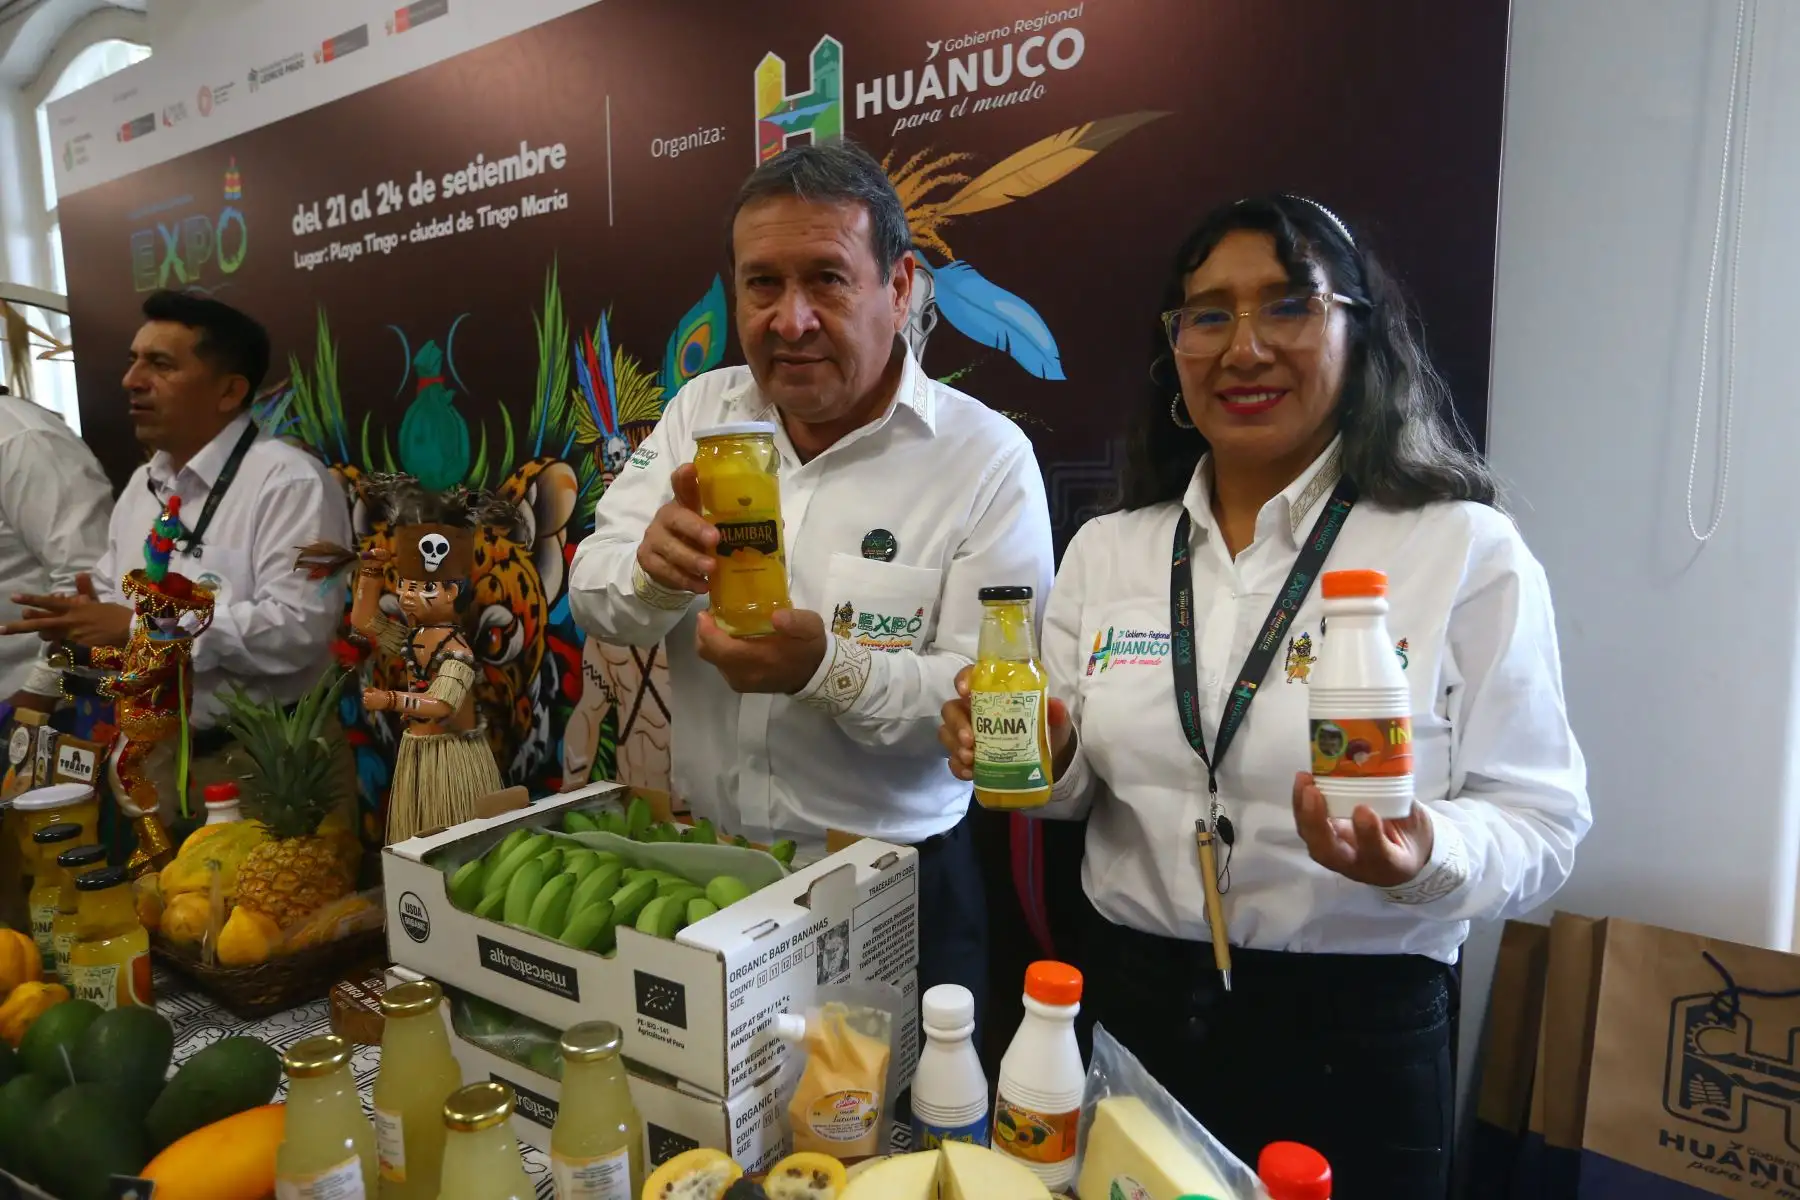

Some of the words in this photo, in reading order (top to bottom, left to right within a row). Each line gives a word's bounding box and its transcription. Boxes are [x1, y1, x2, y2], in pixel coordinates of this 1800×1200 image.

[944, 26, 1010, 52] Gobierno
[1014, 2, 1084, 34] Regional
[892, 107, 942, 136] para
[950, 97, 968, 118] el
[972, 81, 1047, 113] mundo
[651, 126, 726, 158] Organiza:
[293, 203, 322, 235] del
[326, 194, 347, 228] 21
[351, 188, 371, 222] al
[376, 180, 403, 216] 24
[408, 171, 436, 207] de
[442, 140, 567, 198] setiembre
[131, 205, 247, 292] EXPO
[294, 247, 329, 271] Lugar:
[330, 240, 362, 262] Playa
[364, 233, 398, 255] Tingo
[410, 214, 454, 243] ciudad
[457, 211, 474, 232] de
[477, 204, 518, 229] Tingo
[719, 525, 774, 543] ALMIBAR
[858, 611, 923, 633] EXPO
[1125, 629, 1147, 639] Gobierno
[976, 717, 1027, 735] GRANA
[404, 902, 423, 918] USDA
[729, 953, 767, 983] ORGANIC
[769, 938, 791, 960] BABY
[791, 916, 829, 946] BANANAS
[758, 973, 766, 985] 10
[771, 966, 779, 977] 11
[782, 961, 790, 971] 12
[730, 996, 745, 1011] SIZE
[731, 1021, 748, 1039] KEEP
[748, 1015, 756, 1027] AT
[731, 1028, 756, 1050] HANDLE
[756, 1017, 773, 1032] WITH
[731, 1060, 744, 1075] NET
[744, 1043, 768, 1064] WEIGHT
[732, 1070, 748, 1086] TARE
[748, 1062, 758, 1075] 0.3
[758, 1056, 767, 1067] KG
[736, 1092, 773, 1129] ORGANIC
[737, 1138, 752, 1156] SIZE
[754, 1155, 763, 1168] AT
